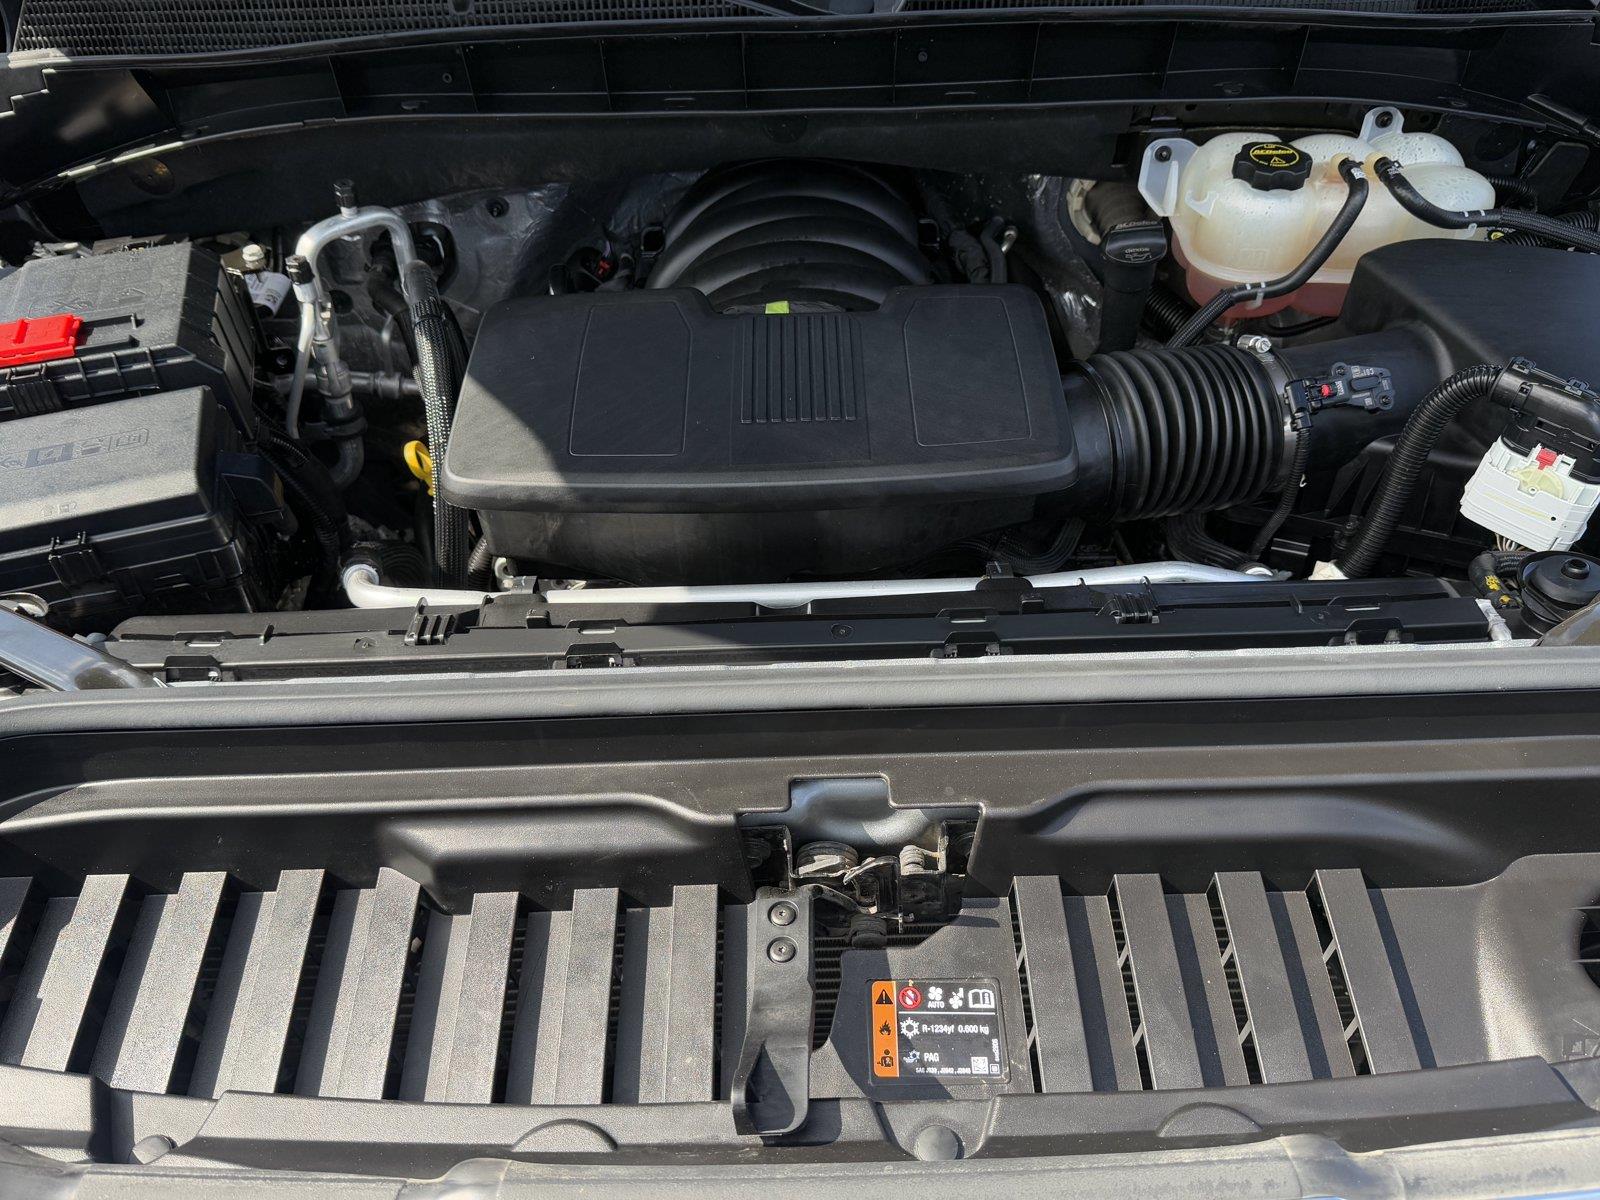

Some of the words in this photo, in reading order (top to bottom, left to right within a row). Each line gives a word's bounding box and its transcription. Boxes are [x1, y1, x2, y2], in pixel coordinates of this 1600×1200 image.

[927, 1001, 945, 1009] AUTO
[922, 1024, 955, 1035] R-1234yf
[979, 1024, 990, 1035] kg
[923, 1052, 940, 1062] PAG
